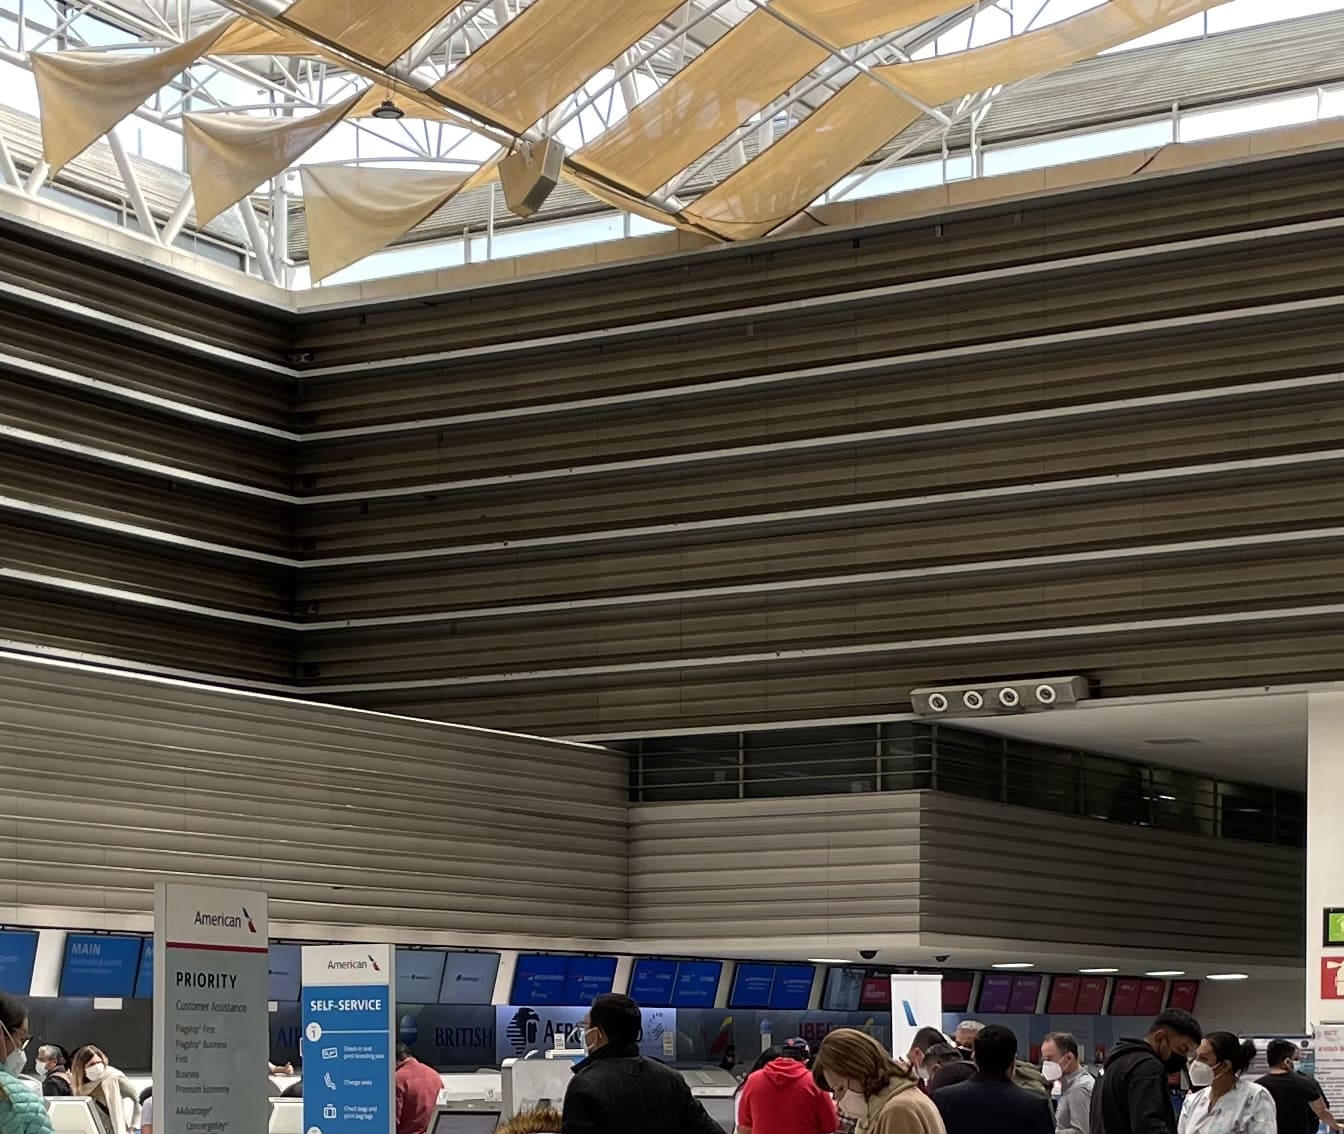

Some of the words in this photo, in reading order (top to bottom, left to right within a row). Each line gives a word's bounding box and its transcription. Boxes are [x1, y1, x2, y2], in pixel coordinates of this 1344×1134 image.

[194, 911, 242, 928] American
[72, 944, 101, 956] MAIN
[328, 960, 368, 970] American
[176, 971, 238, 988] PRIORITY
[176, 1000, 209, 1011] Customer
[211, 1002, 248, 1013] Assistance
[310, 1000, 382, 1012] SELF-SERVICE
[312, 1030, 316, 1038] 1
[434, 1024, 494, 1048] BRITISH
